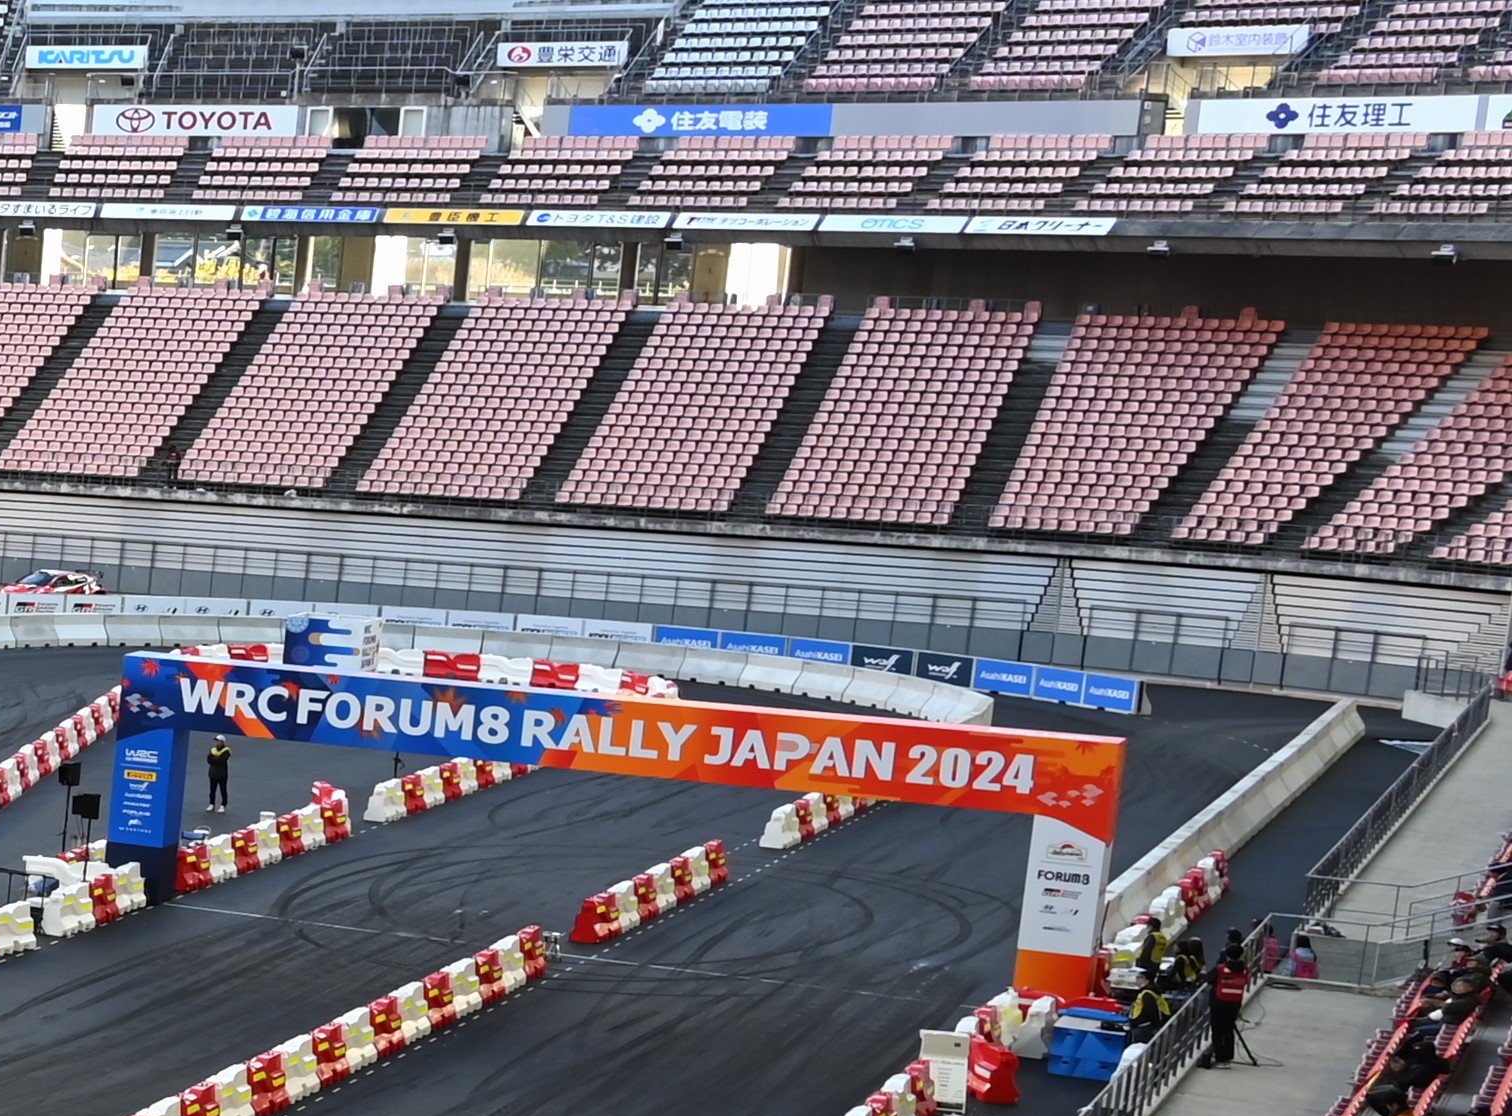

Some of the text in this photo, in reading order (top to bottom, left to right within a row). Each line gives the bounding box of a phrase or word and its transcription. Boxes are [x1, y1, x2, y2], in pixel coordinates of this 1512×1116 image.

[537, 46, 617, 64] 豊栄交通
[162, 111, 272, 130] TOYOTA
[671, 111, 768, 131] 住友電装
[1308, 103, 1414, 128] 住友理工
[266, 208, 373, 221] 碧海信用金庫
[428, 212, 501, 222] 豊臣機工
[179, 677, 1036, 795] WRC FORUM8 RALLY JAPAN 2024
[1037, 869, 1090, 885] FORUM8
